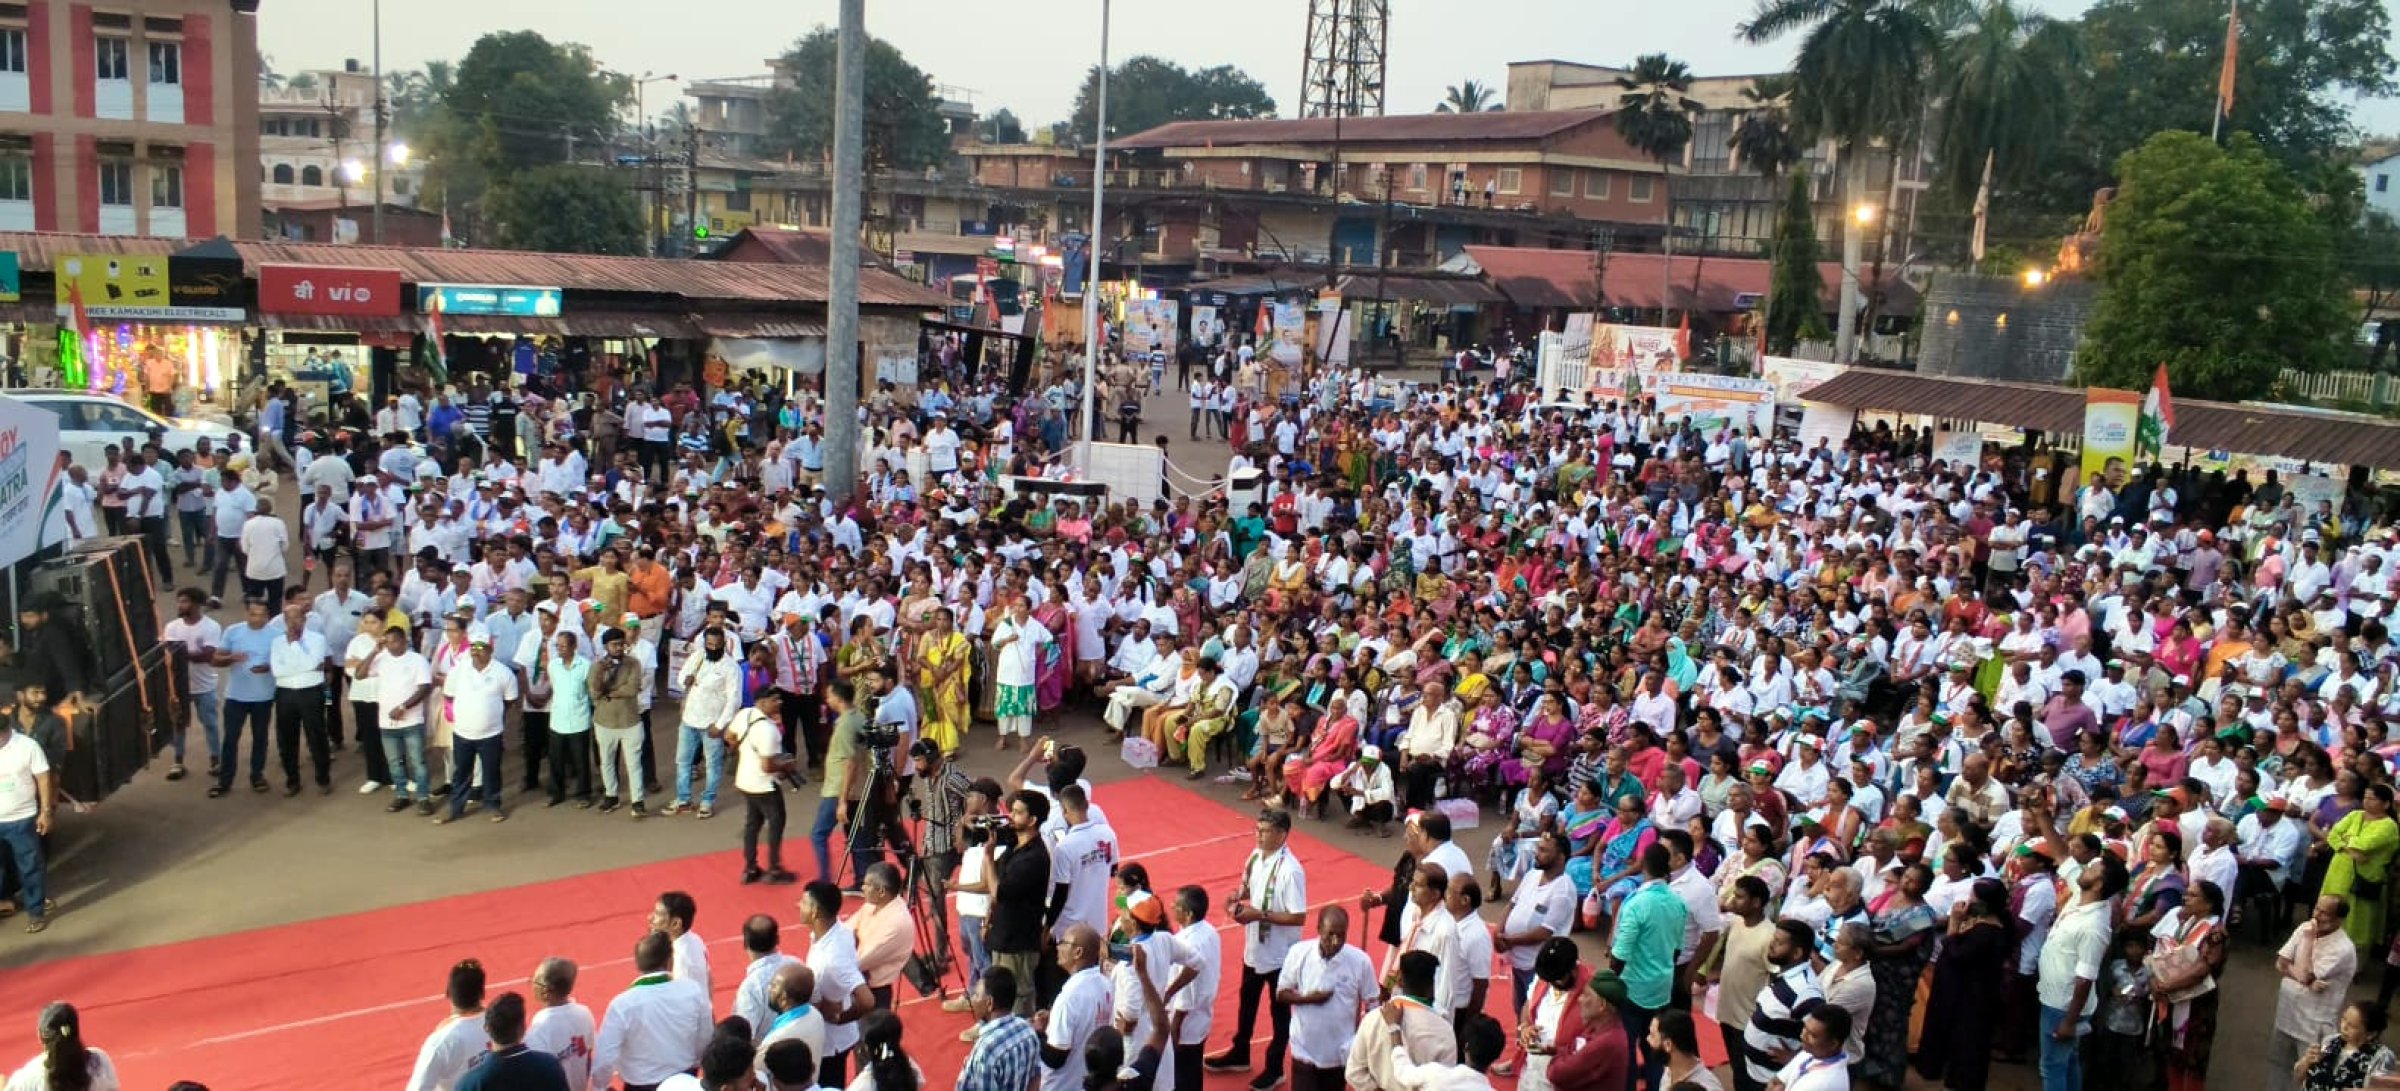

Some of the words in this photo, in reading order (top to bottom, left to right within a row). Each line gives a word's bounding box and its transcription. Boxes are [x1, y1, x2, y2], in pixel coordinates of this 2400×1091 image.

[292, 279, 315, 301] वी
[108, 307, 163, 317] KAMAKSHI
[165, 308, 227, 318] ELECTRICALS
